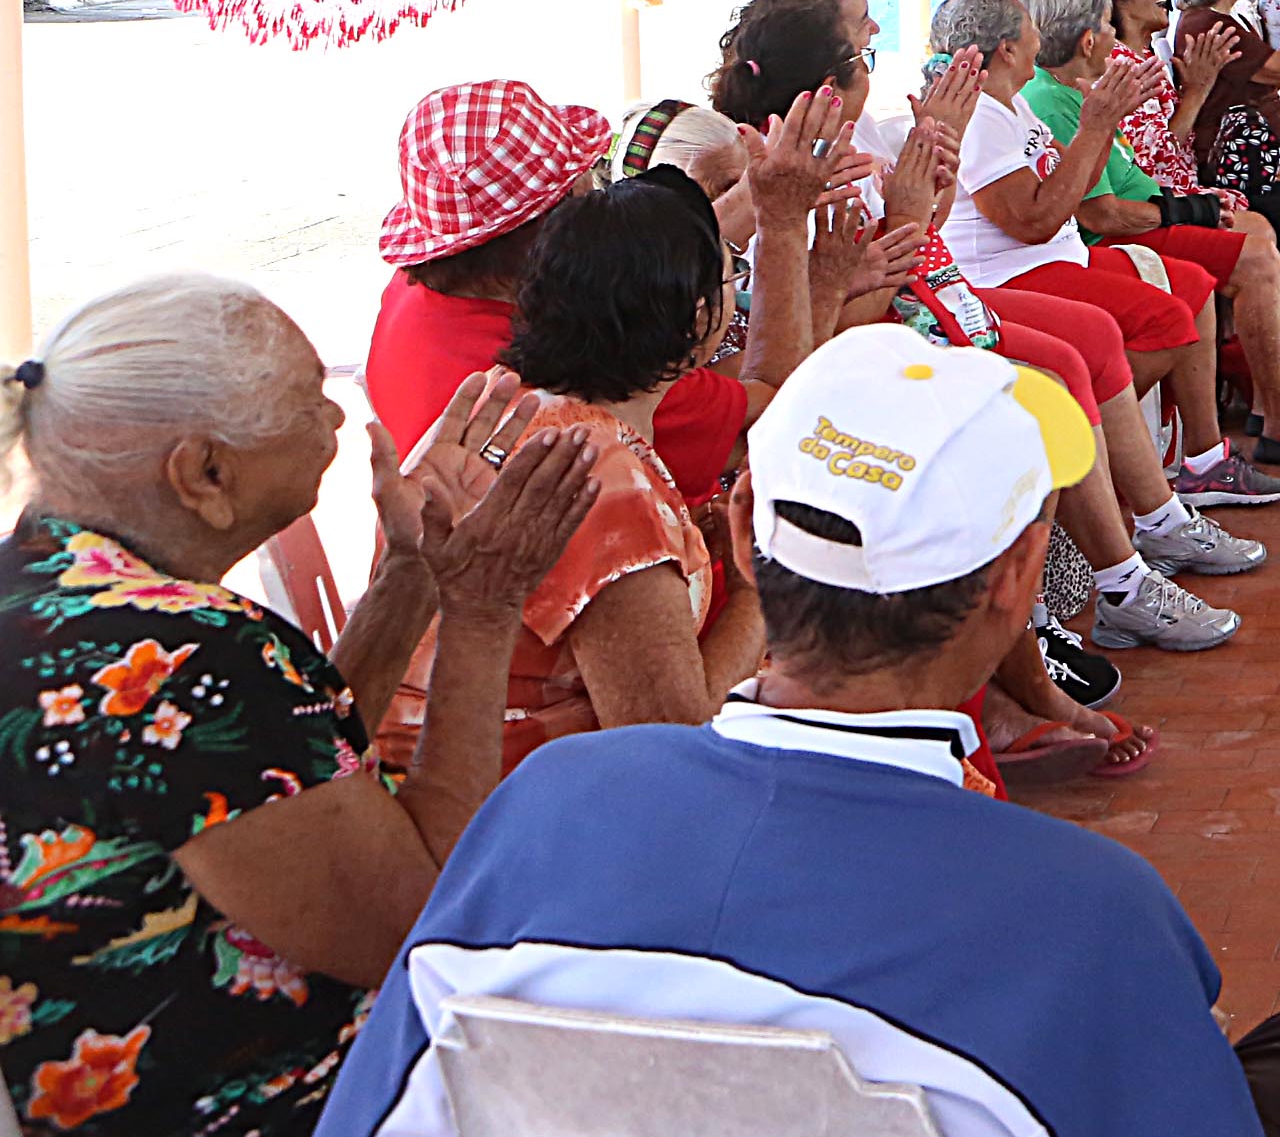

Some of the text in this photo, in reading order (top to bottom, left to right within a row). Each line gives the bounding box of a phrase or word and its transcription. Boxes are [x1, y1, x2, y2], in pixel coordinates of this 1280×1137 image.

[798, 436, 904, 492] da Casa
[813, 415, 917, 472] Tempero
